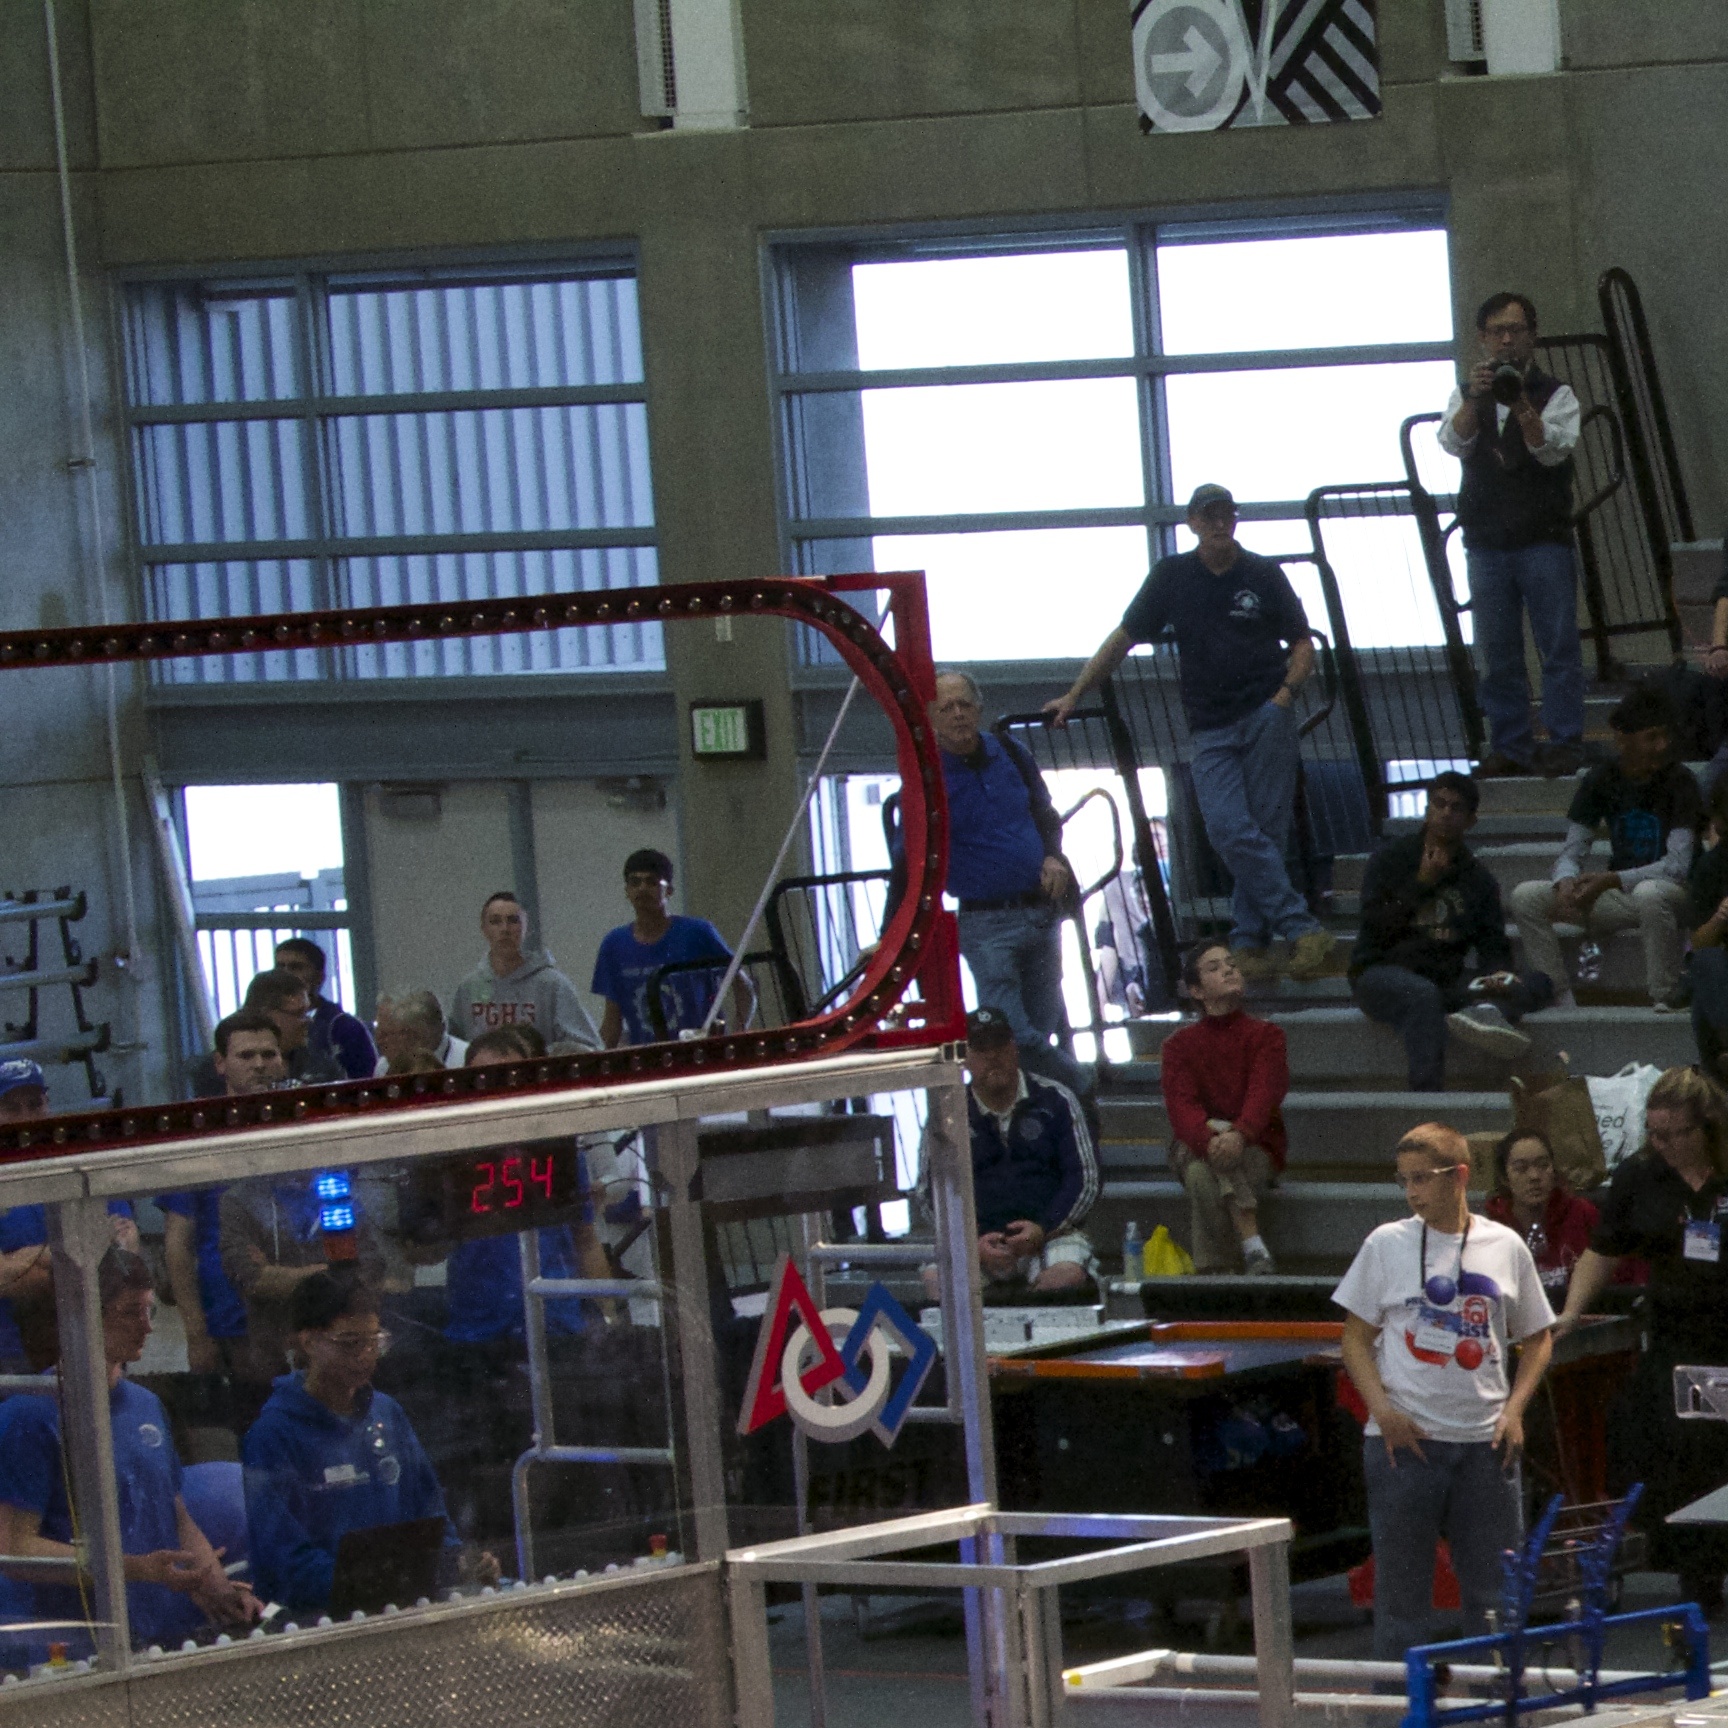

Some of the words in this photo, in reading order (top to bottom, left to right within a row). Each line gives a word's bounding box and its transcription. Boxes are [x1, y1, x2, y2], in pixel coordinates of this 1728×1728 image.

[700, 708, 740, 749] EXIT
[471, 1002, 536, 1027] PGHS
[471, 1156, 553, 1213] 254
